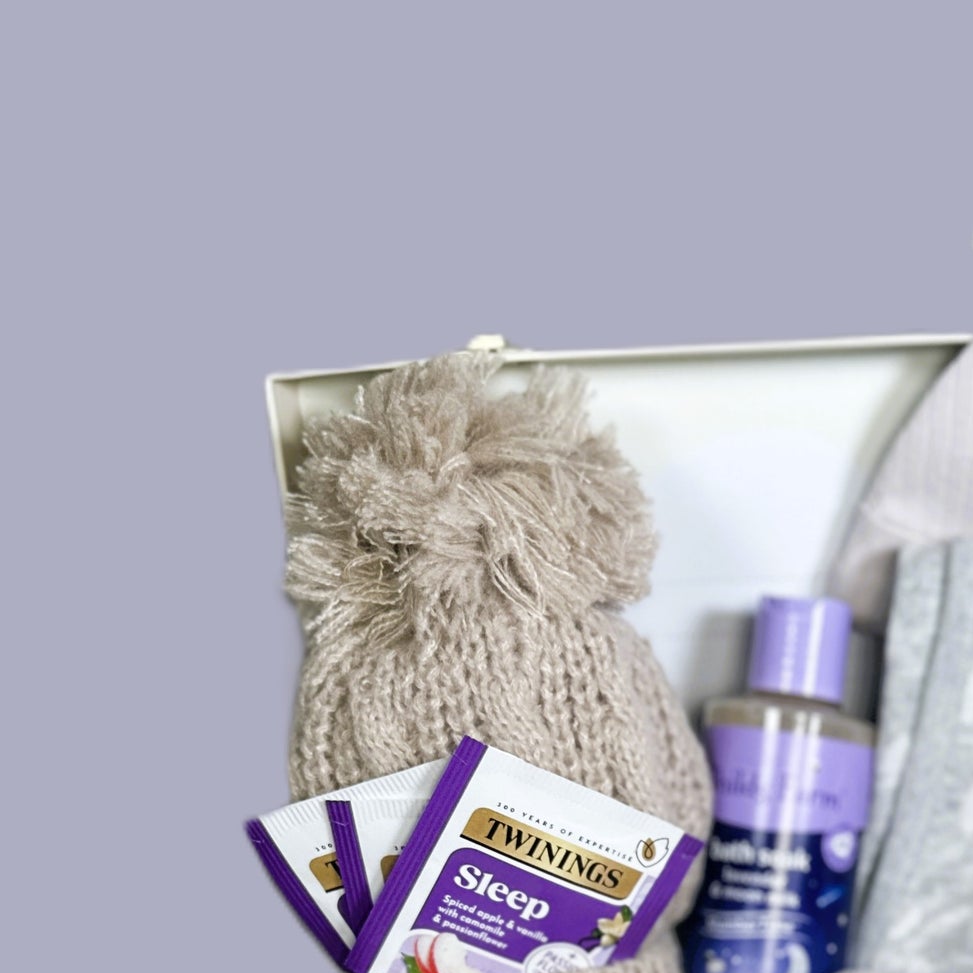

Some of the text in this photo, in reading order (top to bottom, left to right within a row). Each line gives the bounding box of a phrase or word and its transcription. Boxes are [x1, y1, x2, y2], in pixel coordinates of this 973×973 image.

[486, 818, 623, 889] TWININGS
[522, 812, 554, 830] YEARS
[560, 828, 573, 837] OF
[578, 836, 633, 862] EXPERTISE
[453, 864, 550, 921] Sleep
[432, 914, 508, 949] & passionflower
[438, 906, 505, 937] with camomile
[442, 894, 548, 943] Spiced apple & vanilla
